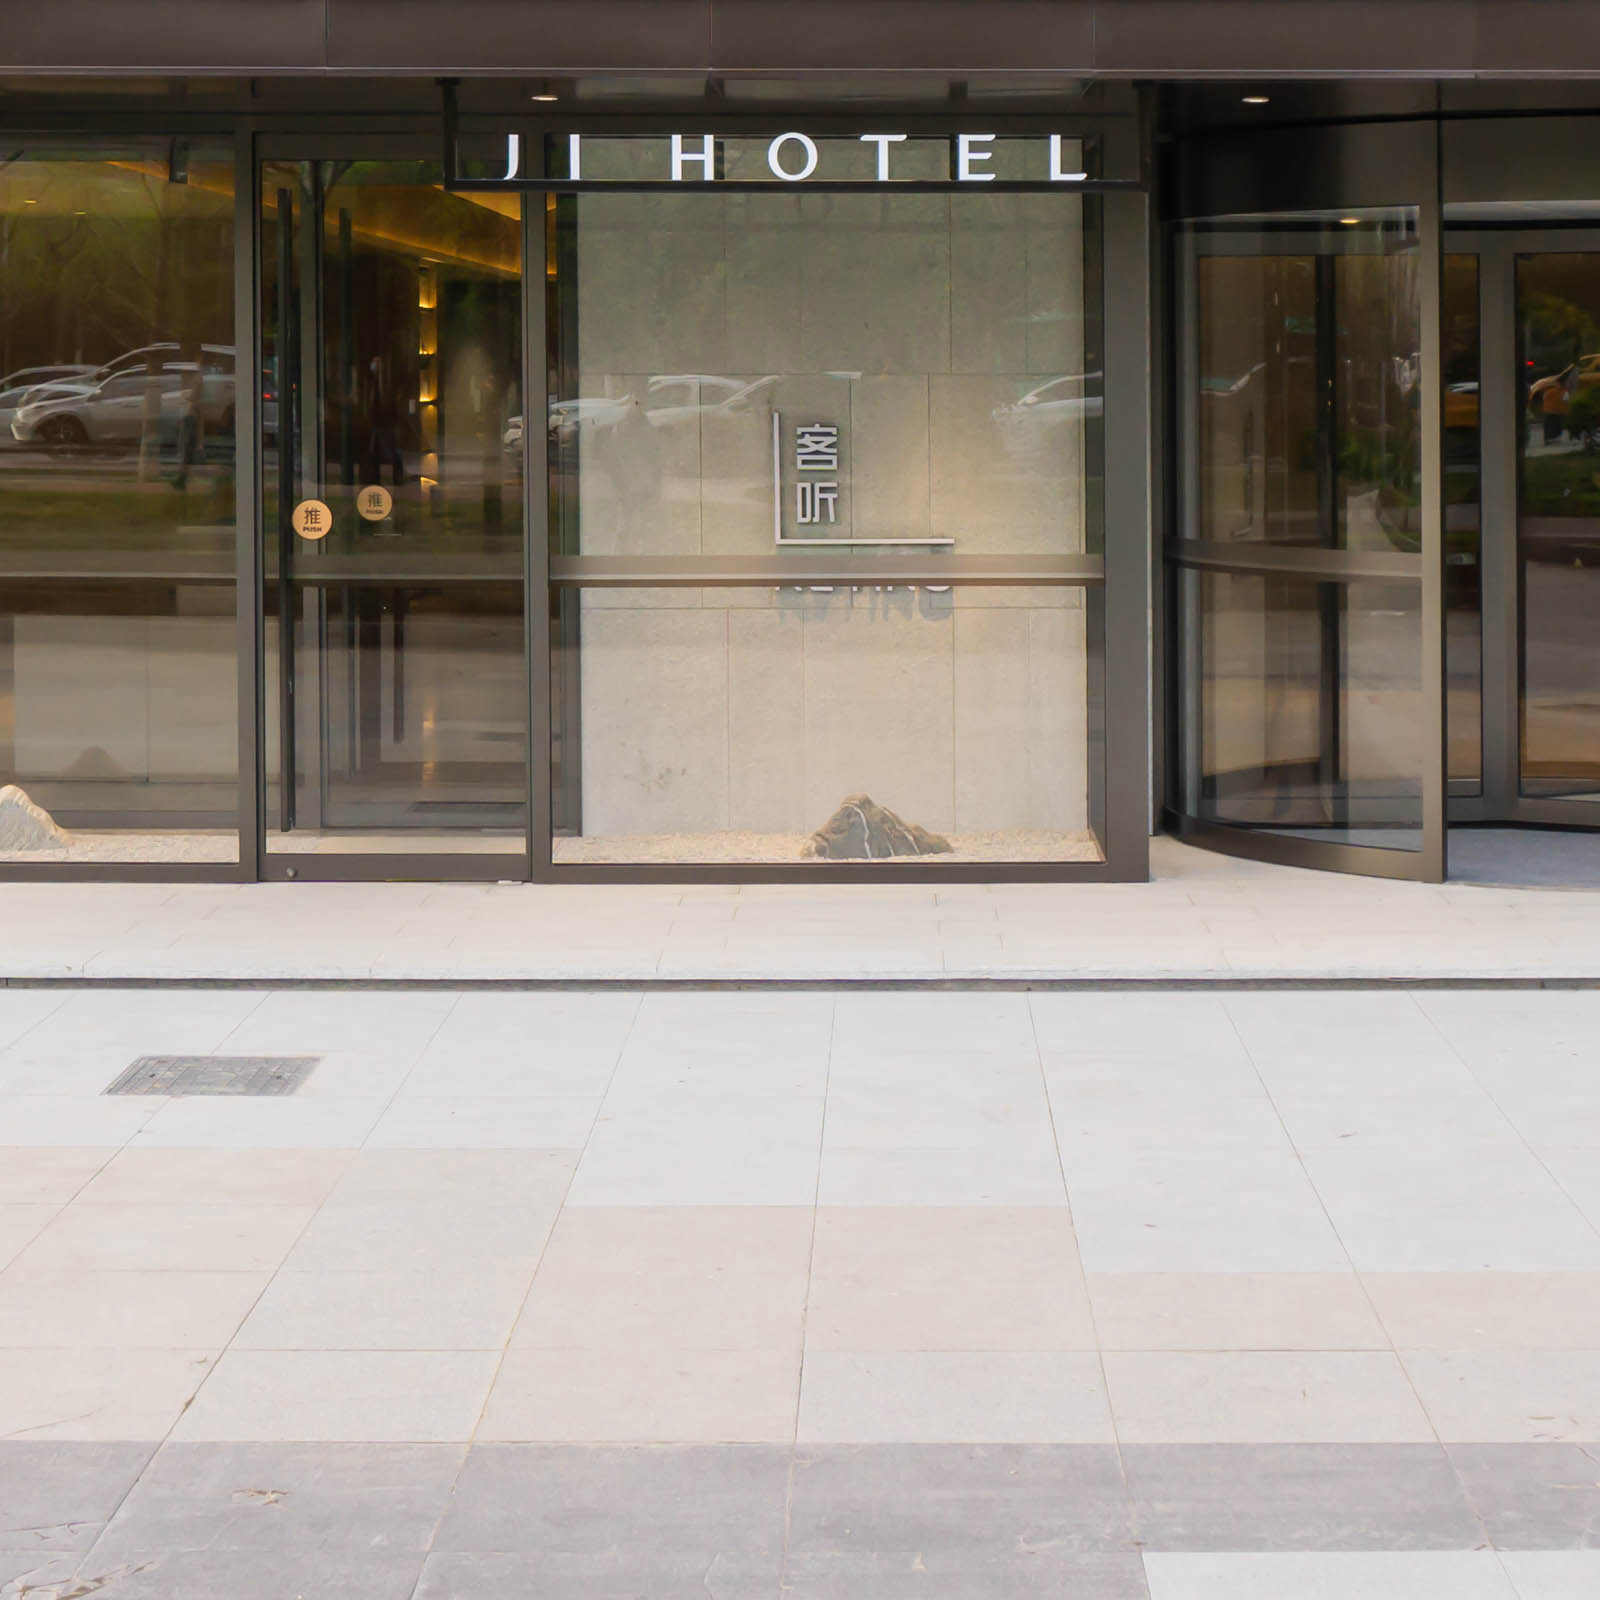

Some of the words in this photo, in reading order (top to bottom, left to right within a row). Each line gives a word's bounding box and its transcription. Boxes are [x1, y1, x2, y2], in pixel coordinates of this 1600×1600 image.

[503, 133, 582, 181] JI
[671, 131, 1089, 182] HOTEL
[796, 422, 839, 524] 客听
[304, 507, 321, 525] 推
